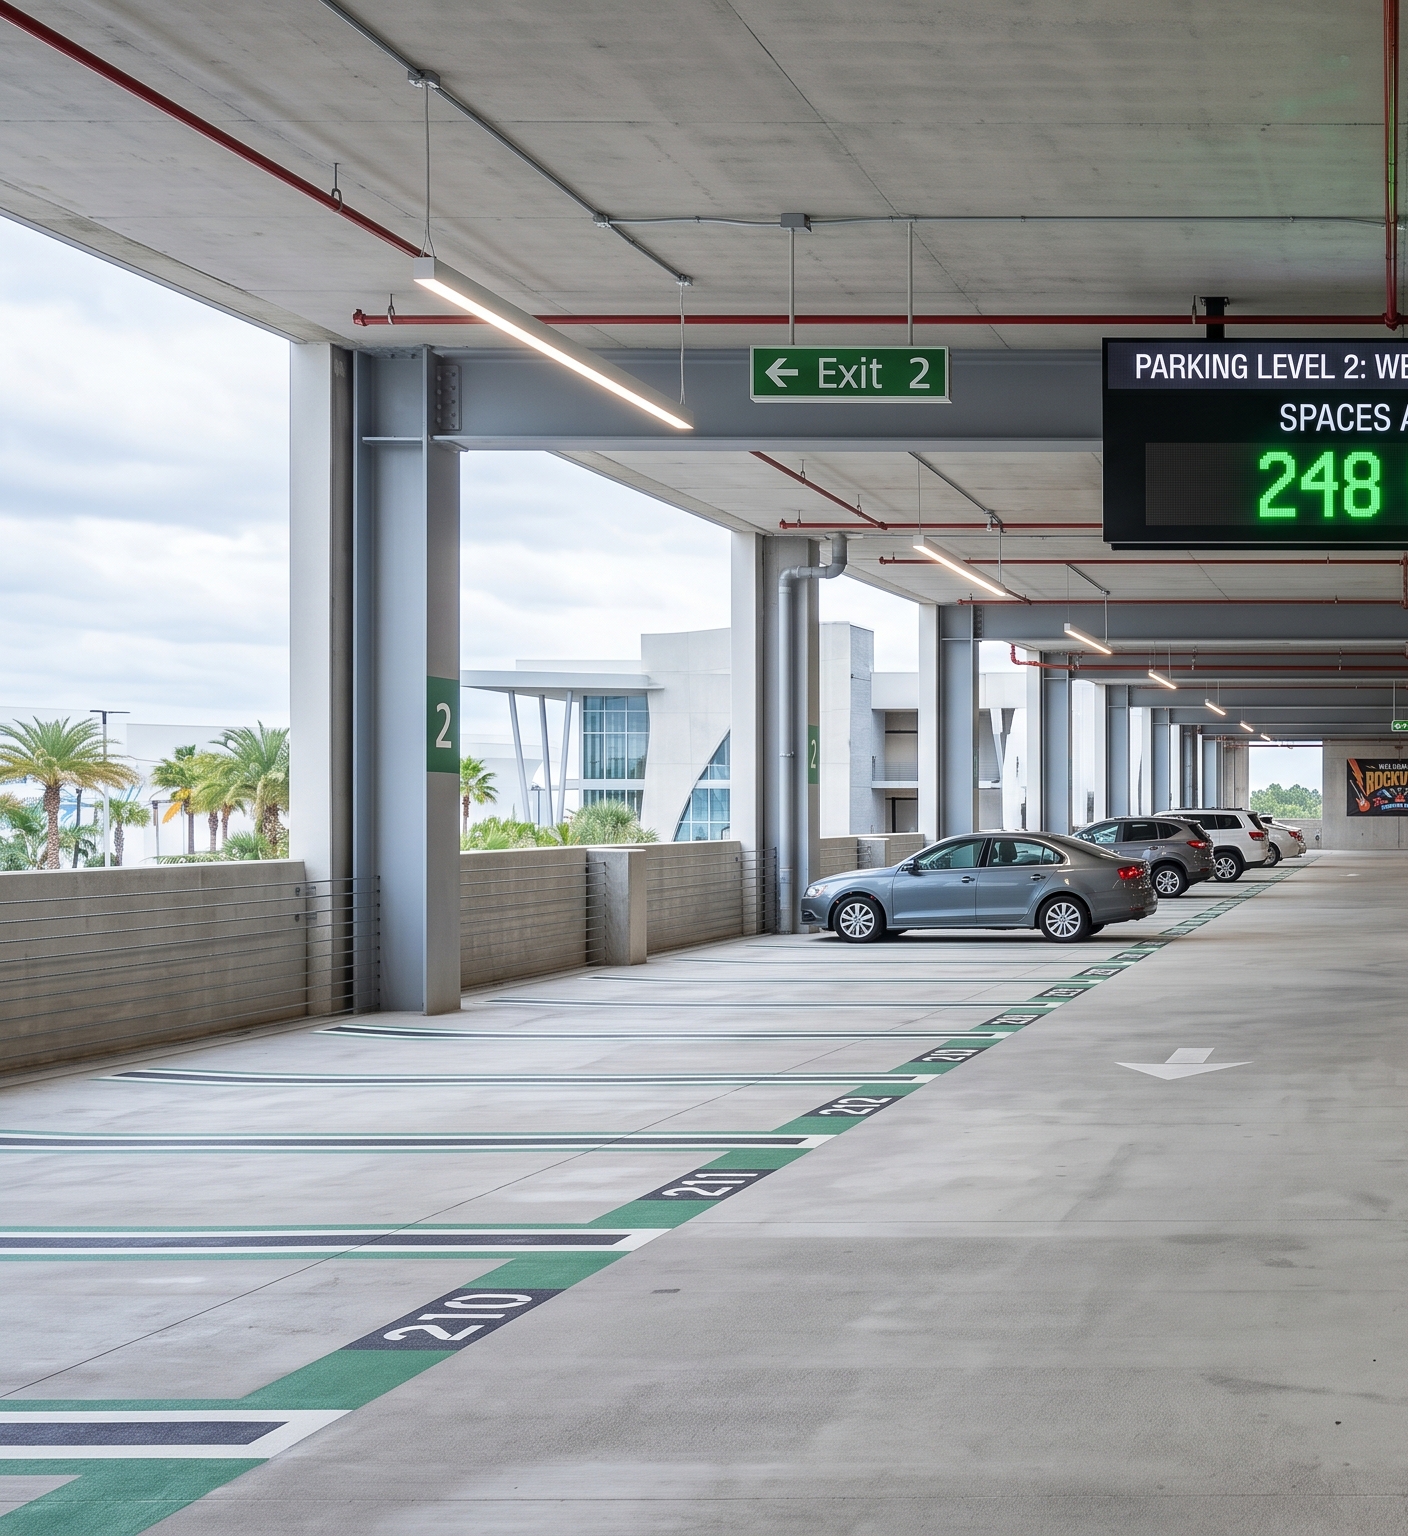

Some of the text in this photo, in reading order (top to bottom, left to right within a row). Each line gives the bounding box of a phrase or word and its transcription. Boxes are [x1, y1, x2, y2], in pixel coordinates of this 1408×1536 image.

[818, 356, 931, 389] Exit 2
[1135, 353, 1249, 380] PARKING
[1257, 353, 1336, 380] LEVEL
[1343, 353, 1367, 380] 2:
[1279, 403, 1392, 433] SPACES
[1258, 451, 1381, 518] 248
[435, 702, 452, 749] 2
[810, 739, 817, 769] 2
[818, 1097, 893, 1115] 212
[661, 1172, 759, 1198] 211
[383, 1292, 533, 1342] 210
